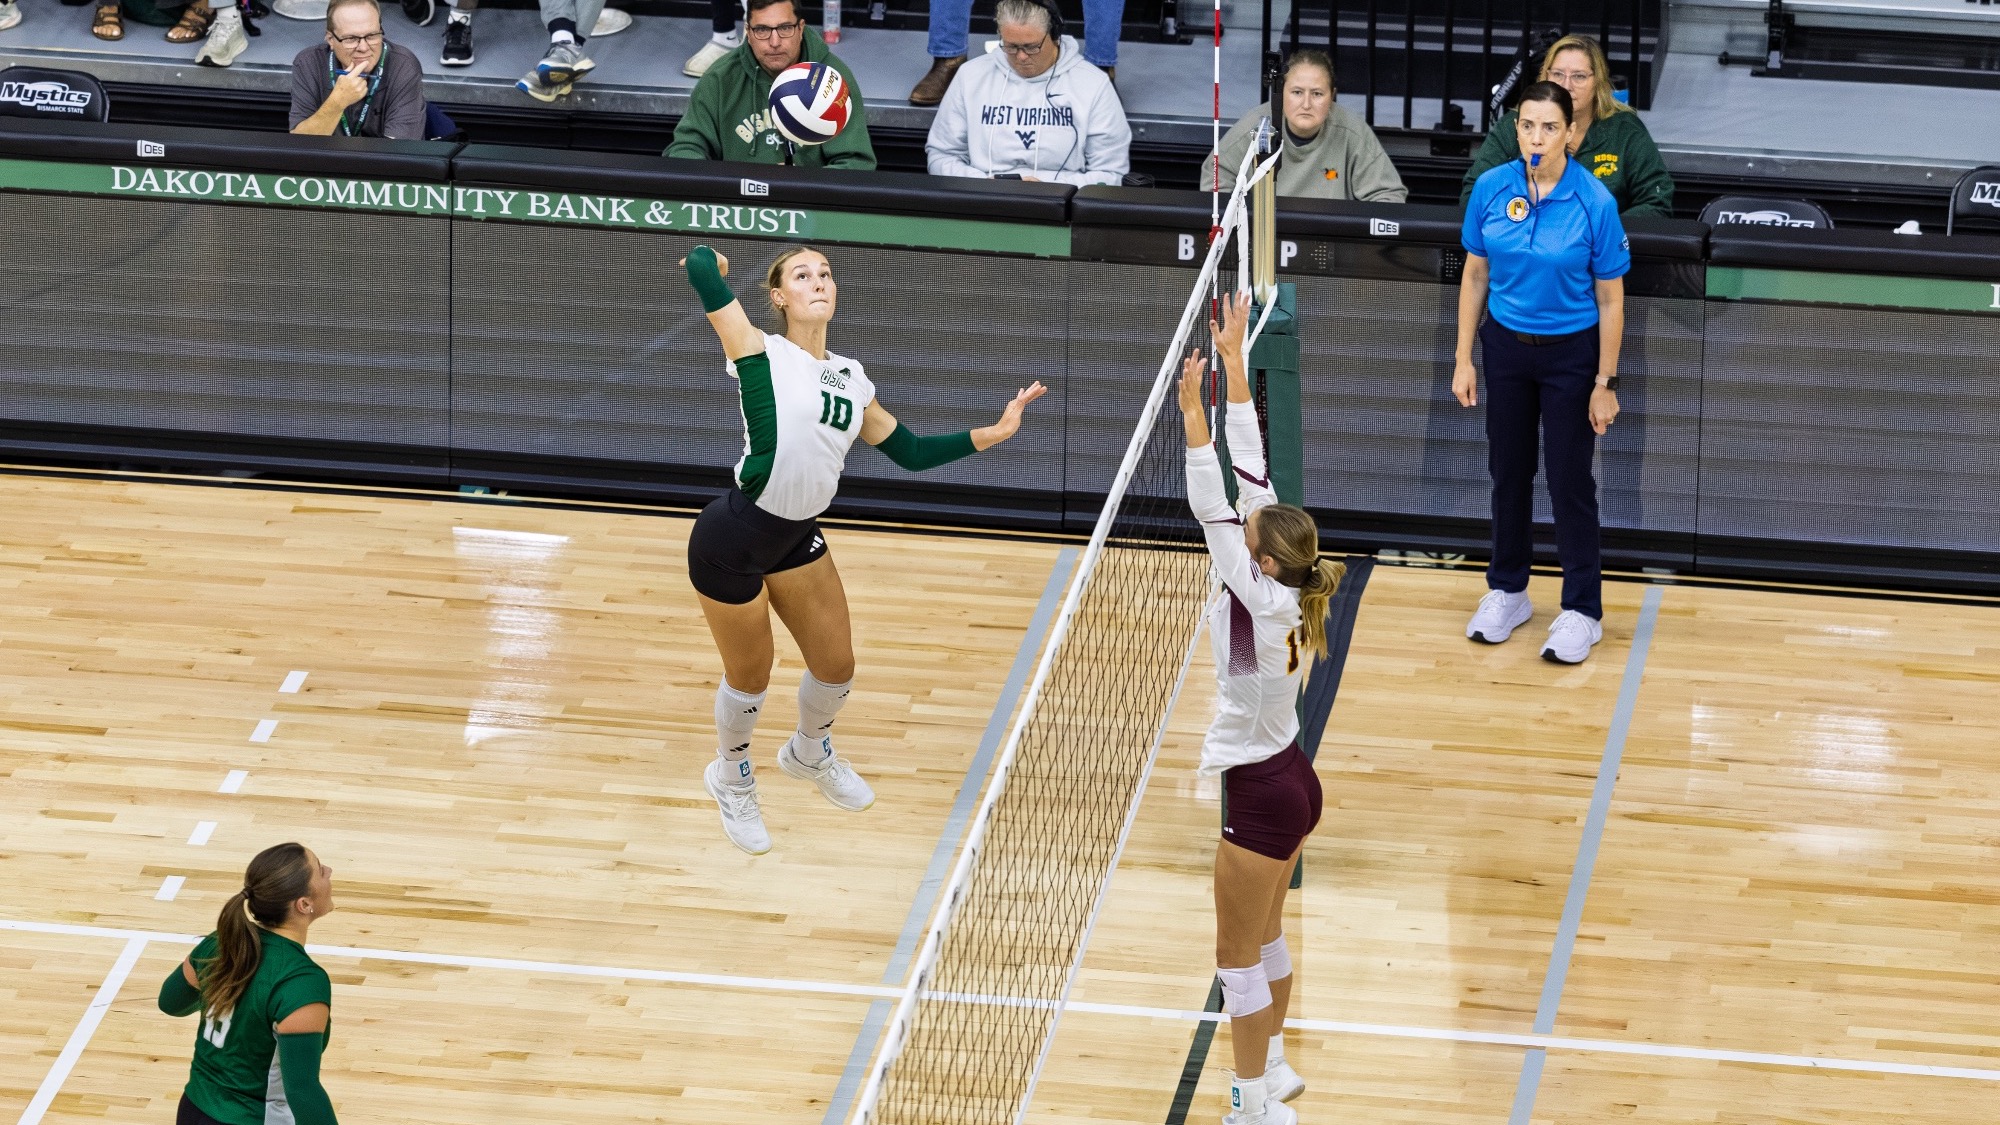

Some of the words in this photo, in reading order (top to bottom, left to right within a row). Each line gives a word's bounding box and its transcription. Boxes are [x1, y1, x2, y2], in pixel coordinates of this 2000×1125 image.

[0, 81, 91, 106] Mystics
[1490, 71, 1517, 110] ARMOUR
[36, 105, 67, 113] BISMARCK
[67, 106, 84, 114] STATE
[981, 104, 1013, 125] WEST
[1016, 106, 1073, 126] VIRGINIA
[144, 144, 163, 155] OES
[111, 166, 265, 199] DAKOTA
[274, 176, 518, 215] COMMUNITY
[528, 192, 635, 223] BANK
[645, 200, 673, 226] &
[681, 202, 806, 234] TRUST
[747, 182, 767, 194] OES
[1970, 182, 2000, 208] M
[1377, 222, 1398, 233] OES
[1178, 234, 1195, 261] B
[1280, 240, 1298, 267] P
[820, 390, 853, 431] 10
